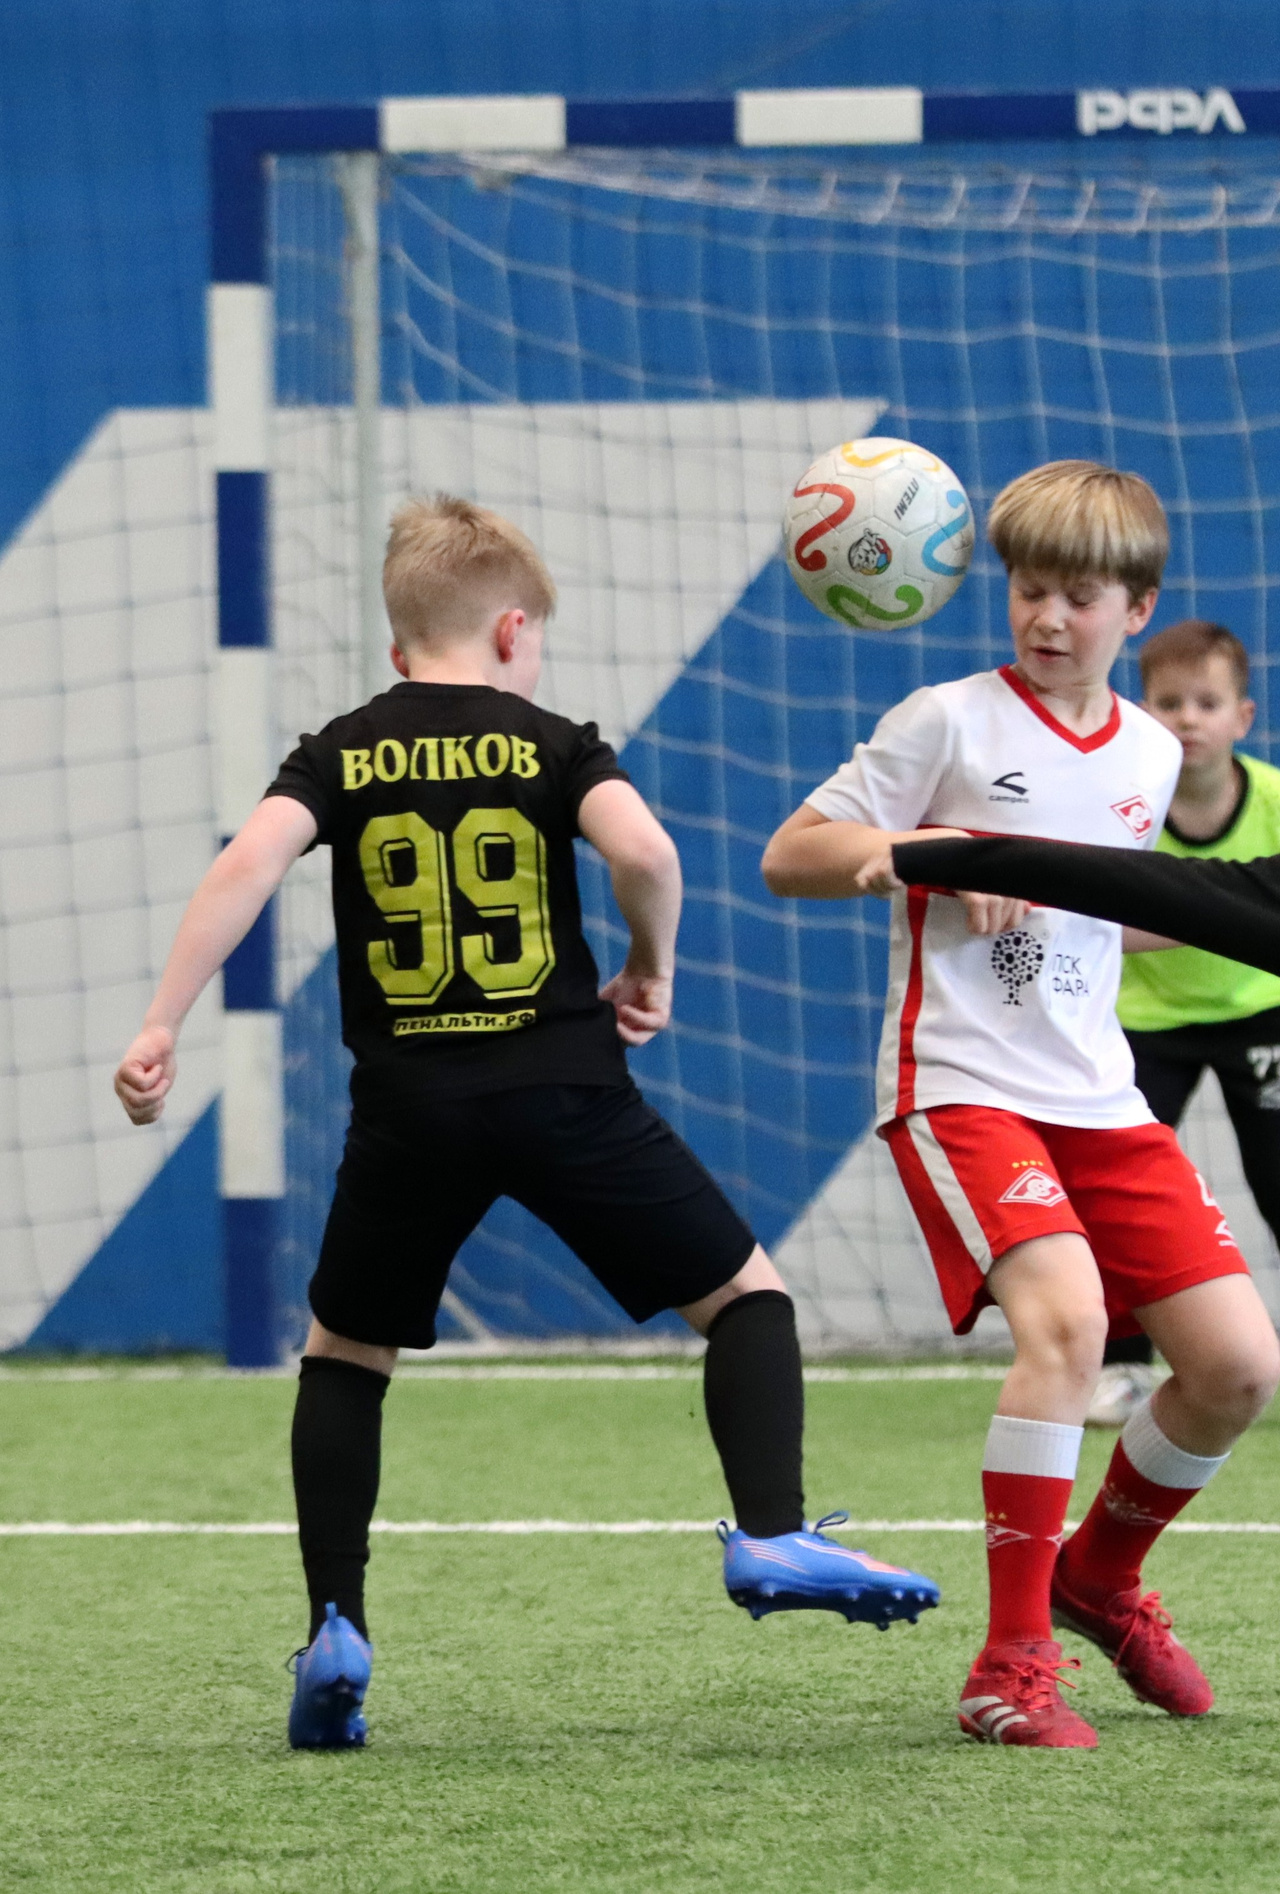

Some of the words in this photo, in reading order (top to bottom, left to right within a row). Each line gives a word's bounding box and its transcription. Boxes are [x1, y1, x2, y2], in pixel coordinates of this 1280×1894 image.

[341, 733, 541, 790] ВОЛКОВ
[359, 807, 556, 1005] 99
[394, 1011, 537, 1034] ПЕНАЛЬТИ.РФ
